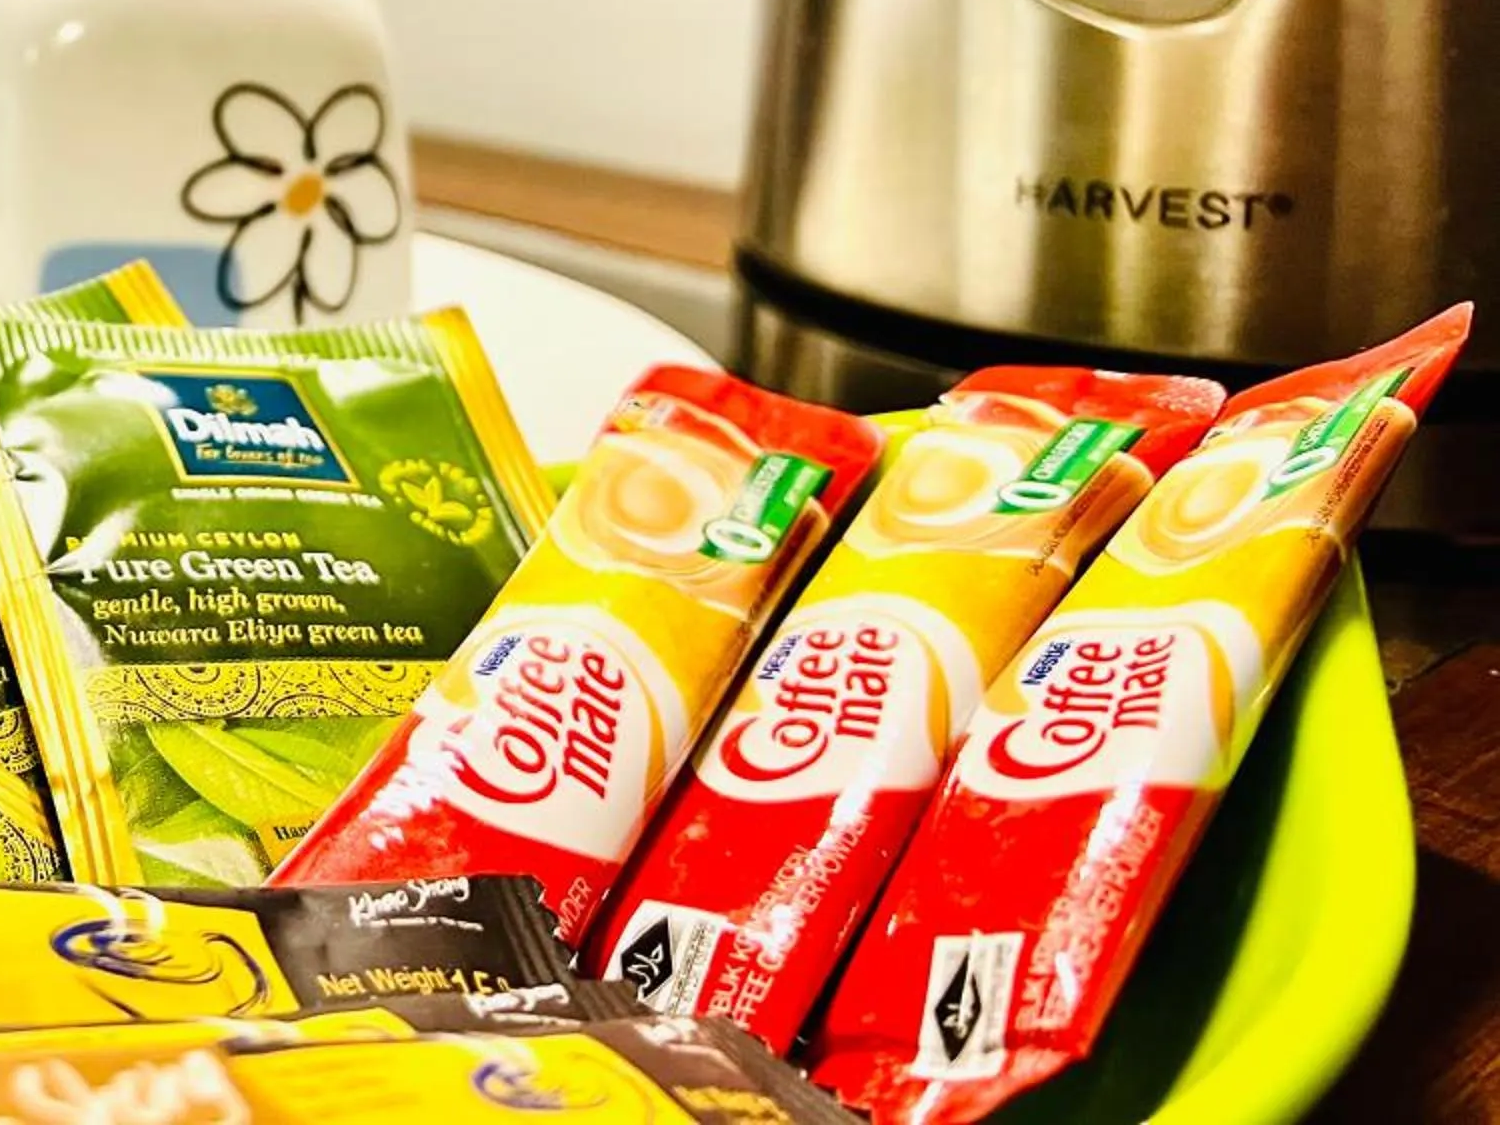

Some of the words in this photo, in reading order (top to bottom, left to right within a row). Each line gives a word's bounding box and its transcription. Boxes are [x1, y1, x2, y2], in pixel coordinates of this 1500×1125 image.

[167, 408, 325, 452] Dilmah
[66, 532, 188, 551] PMIUM
[196, 531, 301, 549] CEYLON
[180, 551, 301, 585] Green
[303, 552, 380, 586] Tea
[93, 589, 181, 620] gentle,
[187, 587, 250, 616] high
[257, 589, 346, 619] grown,
[103, 624, 222, 646] Nuwara
[227, 618, 302, 645] Eliya
[309, 623, 378, 647] green
[383, 622, 423, 644] tea
[720, 630, 846, 782] Coffee
[834, 626, 899, 740] mate
[1111, 634, 1176, 730] mate
[441, 635, 570, 805] Coffee
[562, 648, 626, 800] mate
[988, 642, 1123, 780] Coffee
[349, 888, 408, 927] Khao
[406, 875, 471, 911] Shong
[318, 972, 362, 998] Net
[365, 966, 450, 995] Weight
